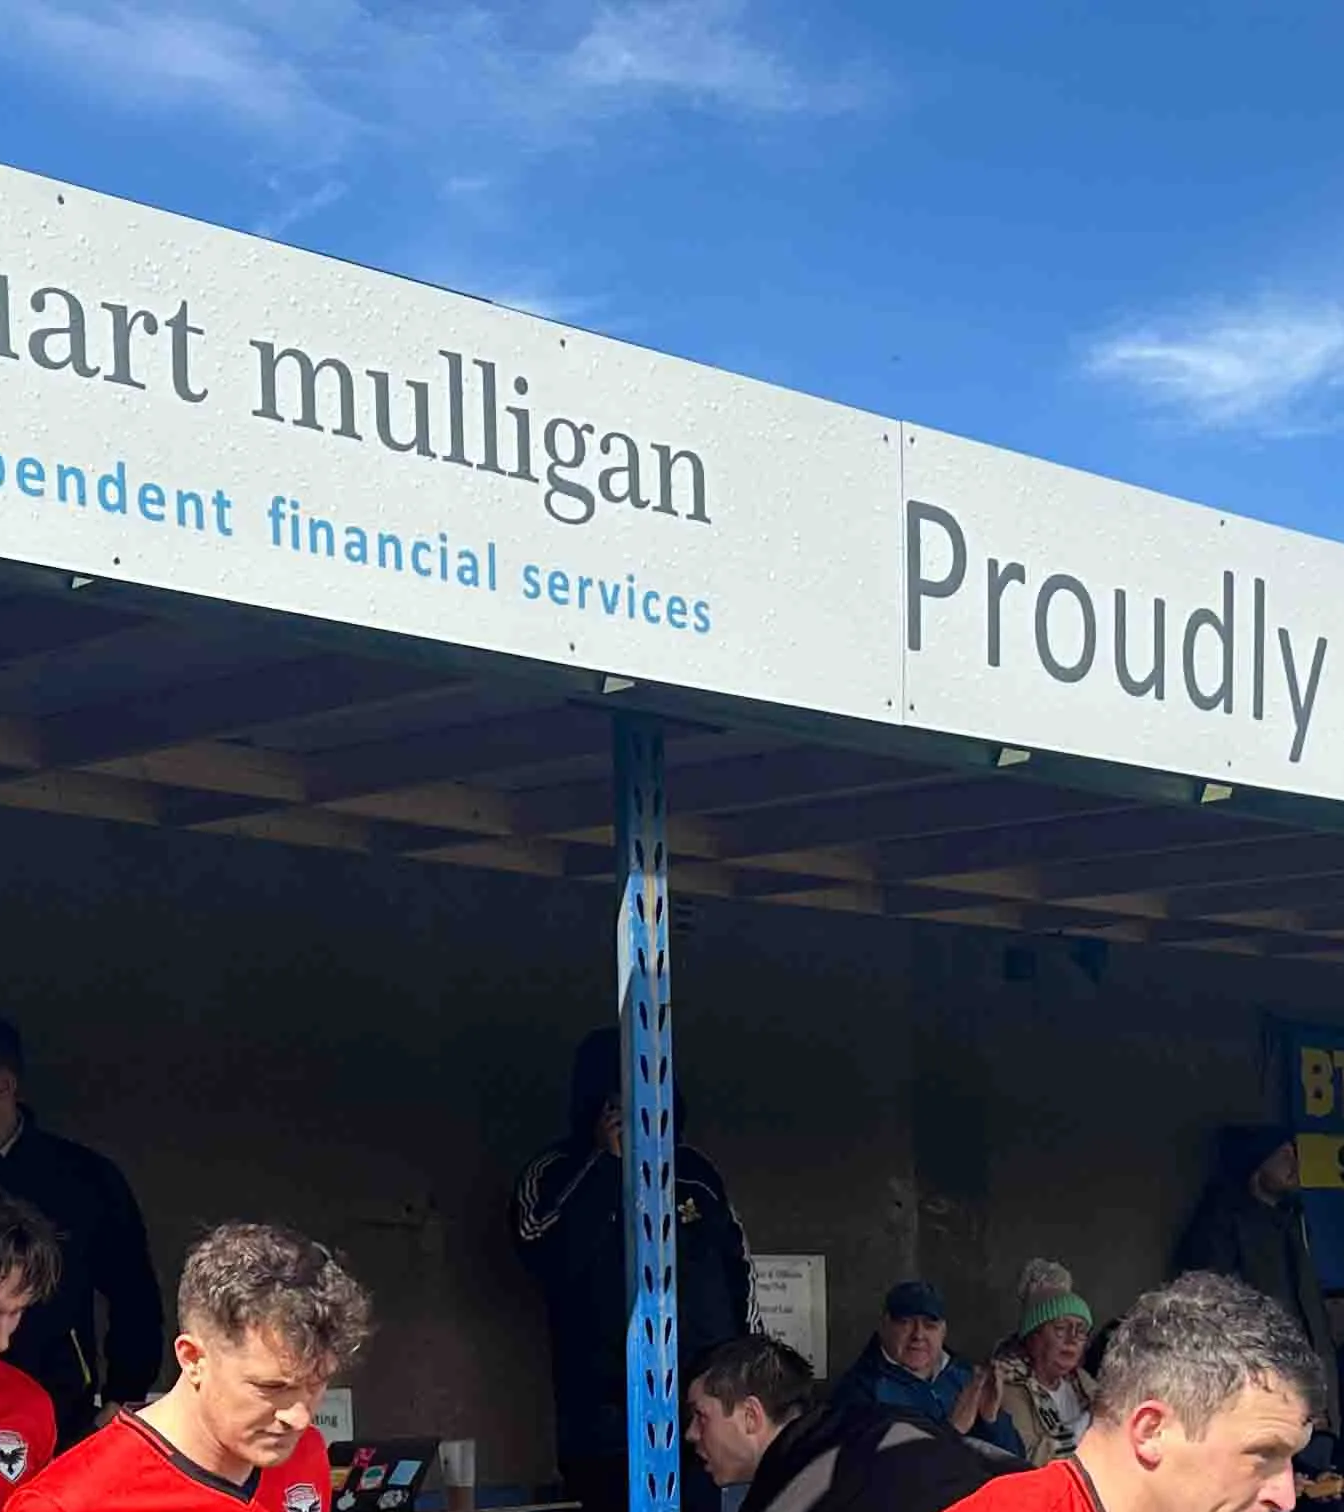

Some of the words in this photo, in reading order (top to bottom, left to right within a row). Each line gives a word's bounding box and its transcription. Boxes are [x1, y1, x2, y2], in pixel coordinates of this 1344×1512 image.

[250, 338, 712, 527] mulligan
[267, 495, 497, 592] financial
[522, 564, 712, 634] services
[906, 500, 1327, 763] Proudly
